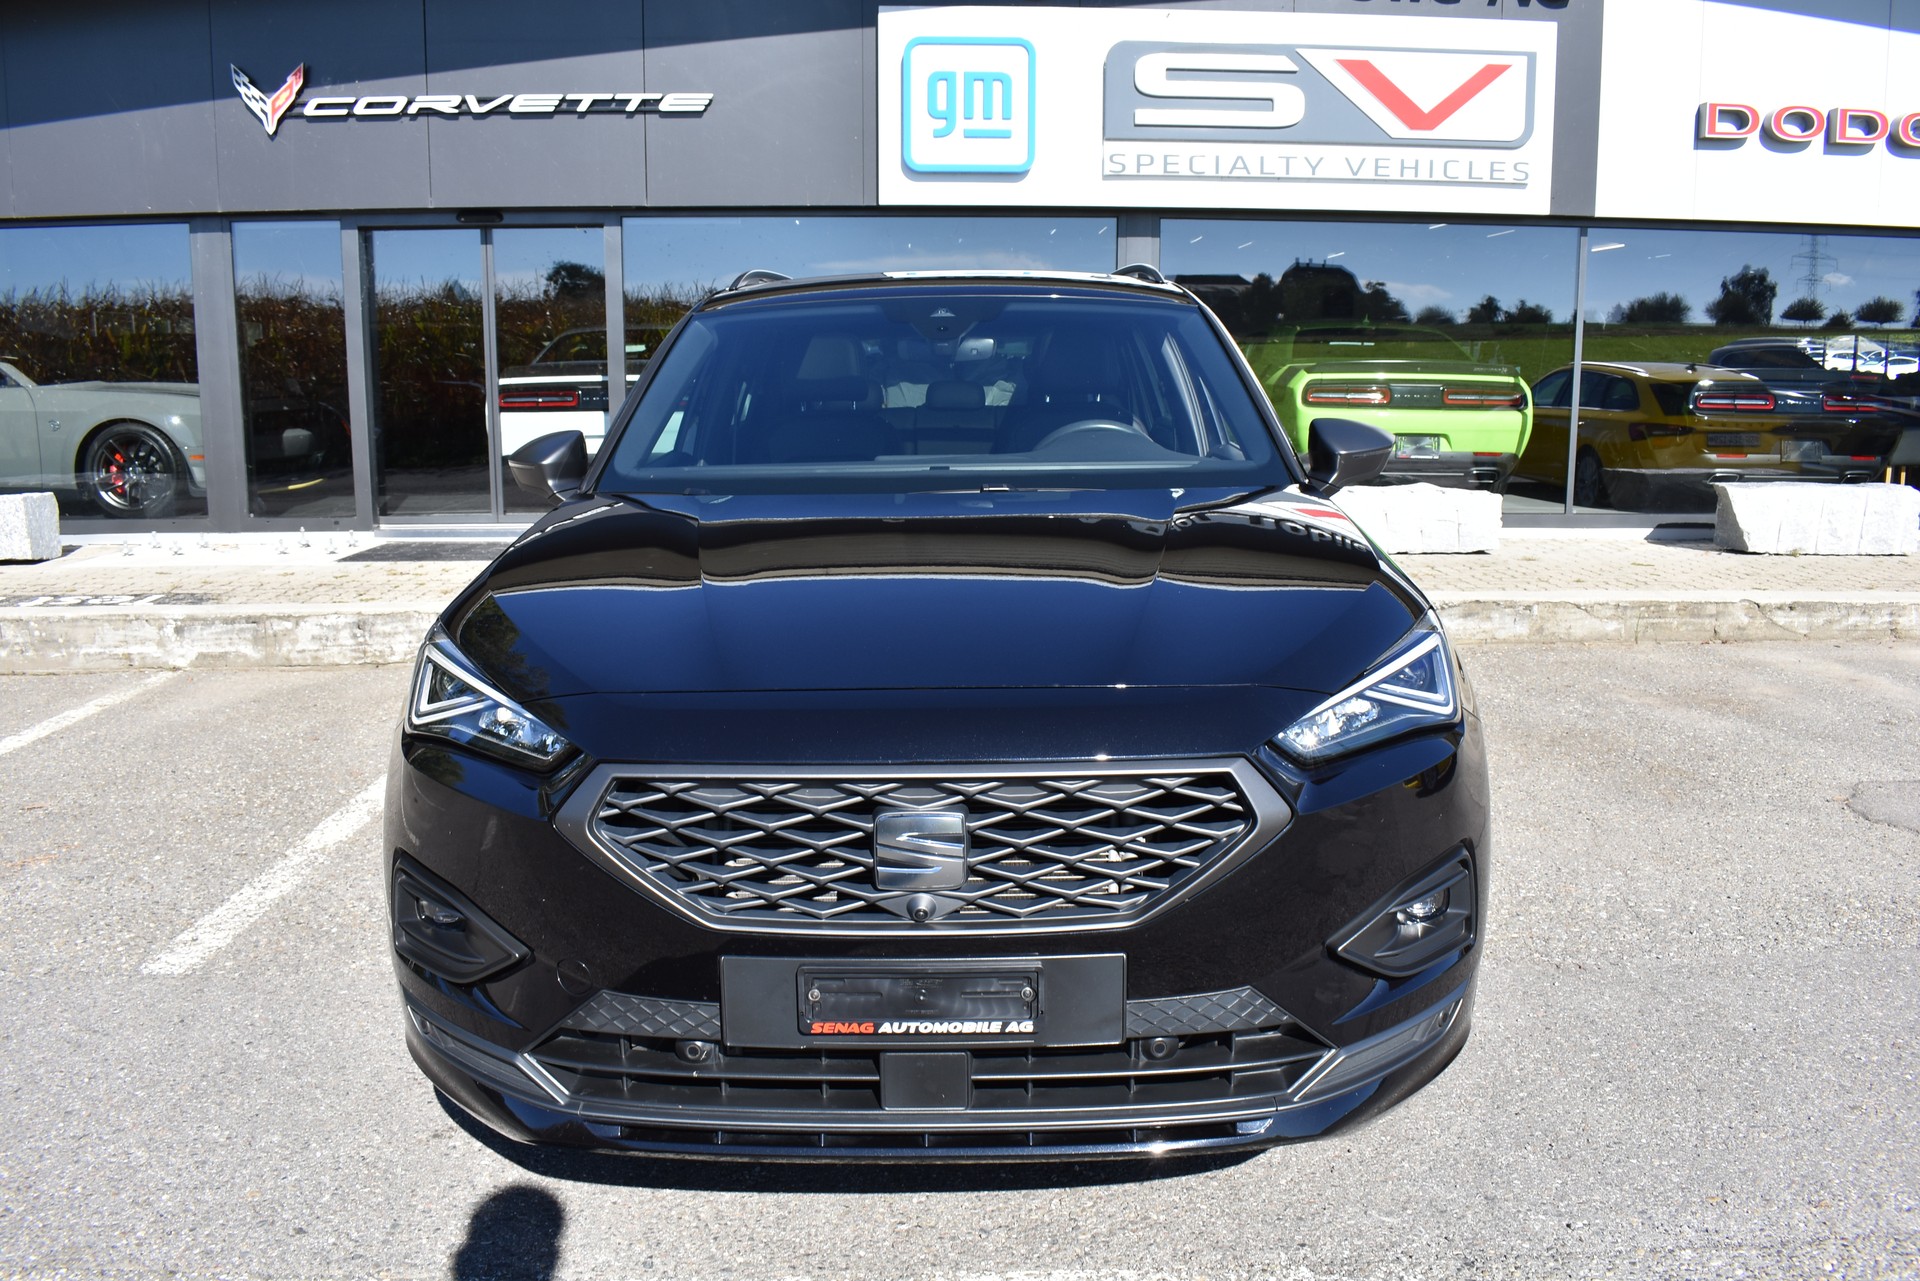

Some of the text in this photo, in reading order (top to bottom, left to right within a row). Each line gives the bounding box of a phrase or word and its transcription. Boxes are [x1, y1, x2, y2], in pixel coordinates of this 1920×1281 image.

[303, 92, 714, 117] CORVETTE
[927, 71, 1012, 138] gm
[1108, 152, 1530, 183] SPECIALTY VEHICLES
[810, 1020, 1034, 1035] SENAG AUTOMOBILE AG
